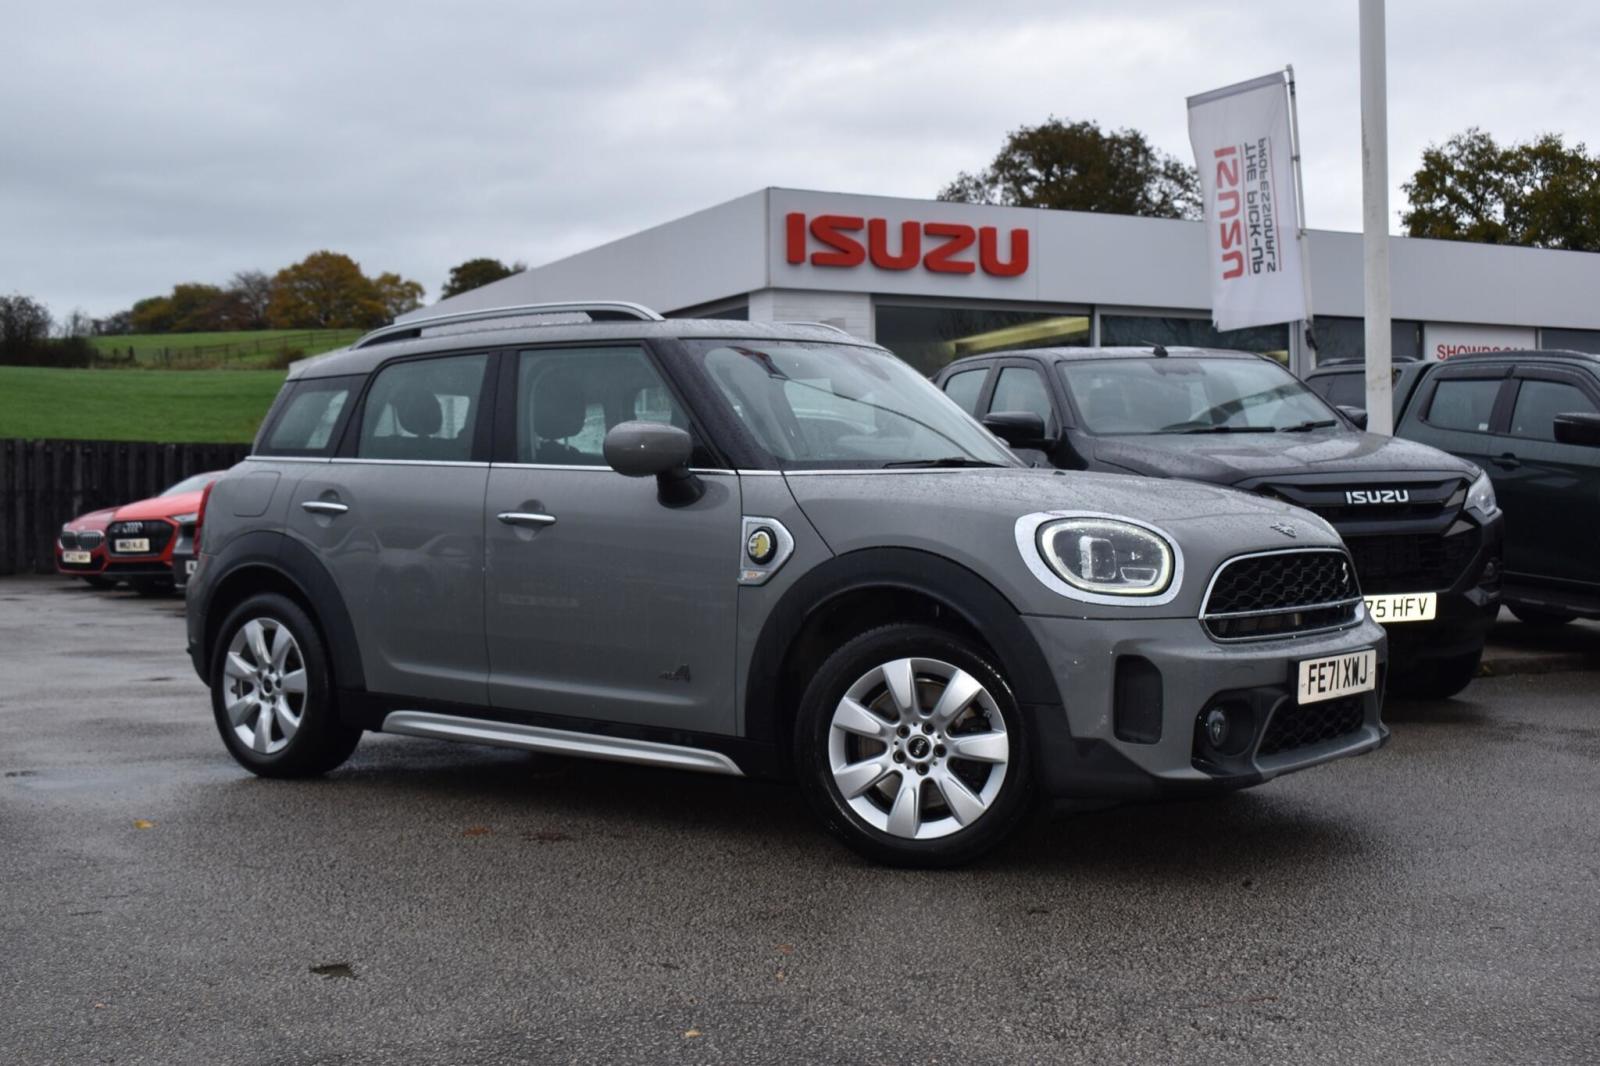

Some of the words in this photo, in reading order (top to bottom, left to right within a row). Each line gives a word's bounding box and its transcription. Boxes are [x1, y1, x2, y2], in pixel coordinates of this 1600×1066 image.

[786, 212, 1029, 277] ISUZU
[1437, 344, 1526, 360] SHOW
[1346, 489, 1409, 504] ISUZU
[1393, 598, 1427, 616] HFV
[1308, 659, 1340, 695] FE71
[1343, 654, 1368, 688] XWJ
